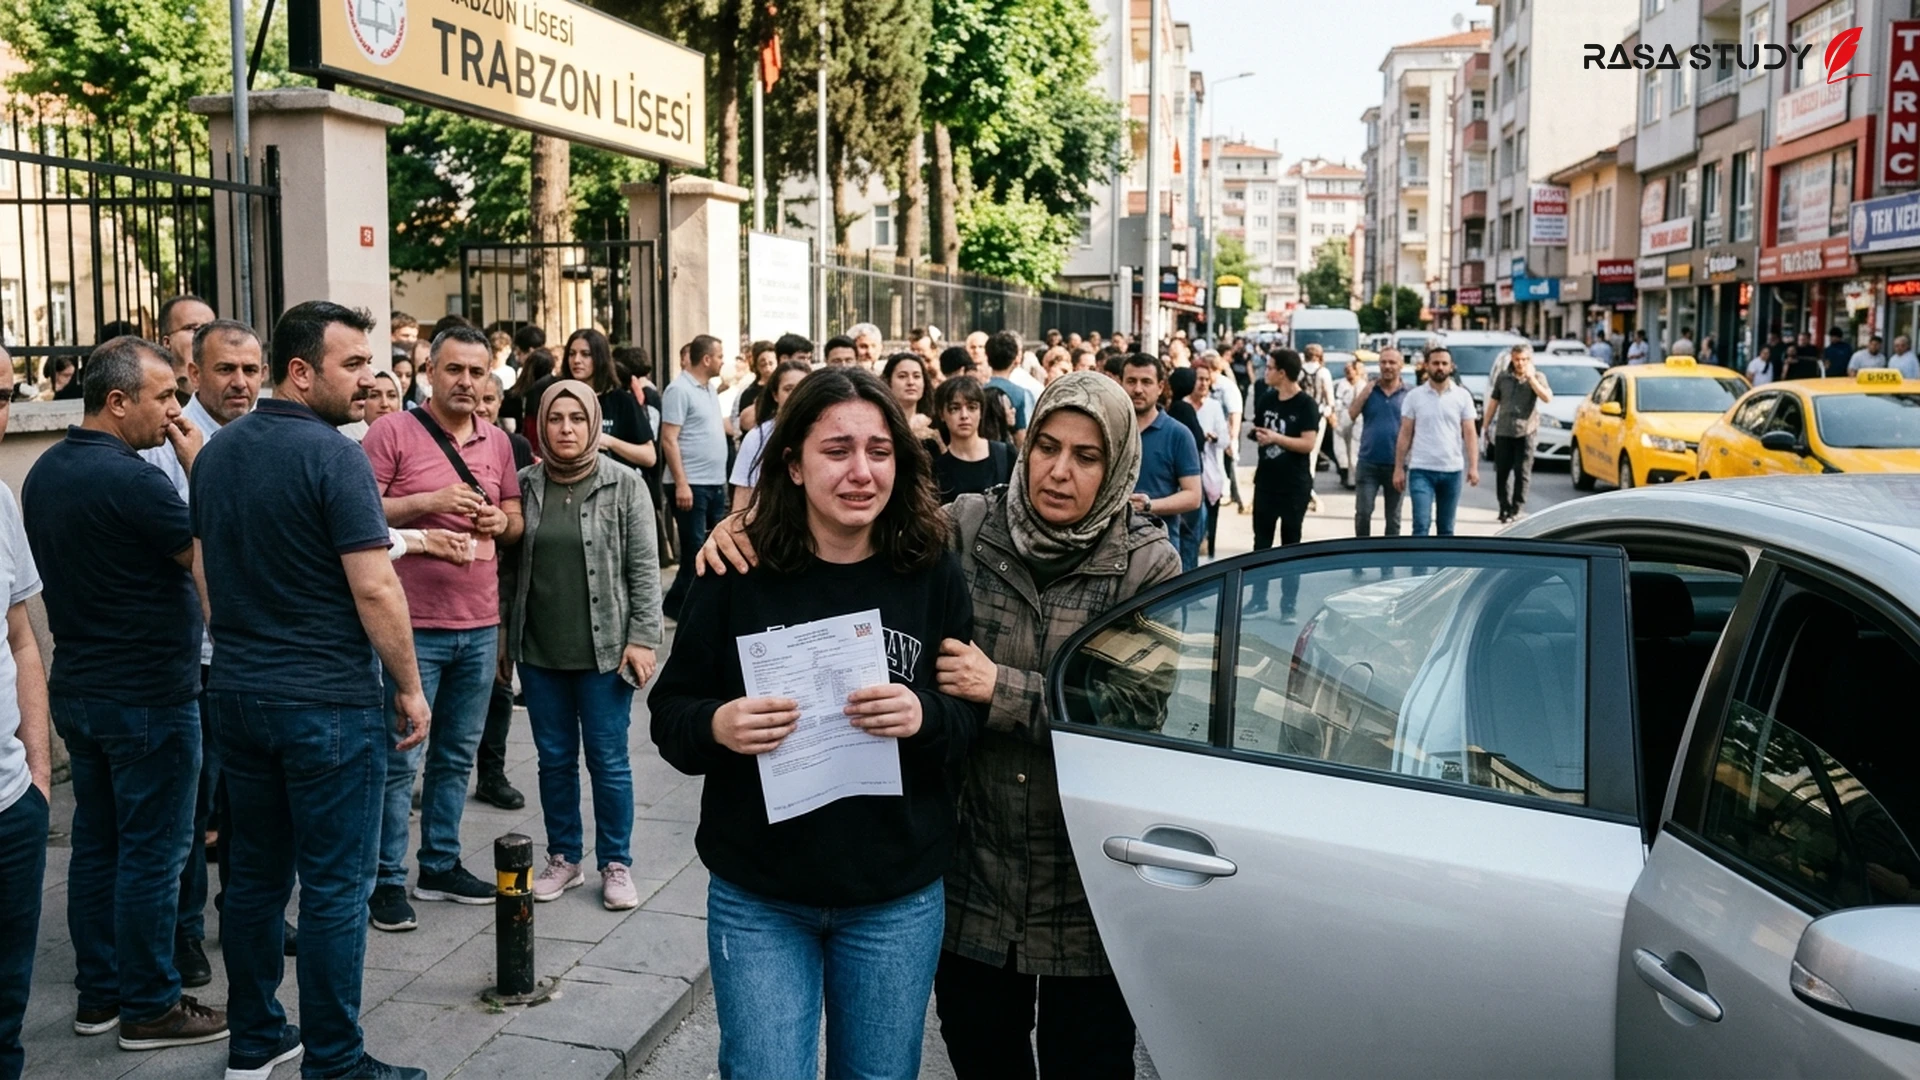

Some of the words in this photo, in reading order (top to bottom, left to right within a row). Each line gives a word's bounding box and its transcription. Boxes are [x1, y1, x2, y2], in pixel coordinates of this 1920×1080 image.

[523, 2, 573, 46] LİSESİ
[432, 17, 600, 119] TRABZON
[613, 72, 692, 144] LİSESİ
